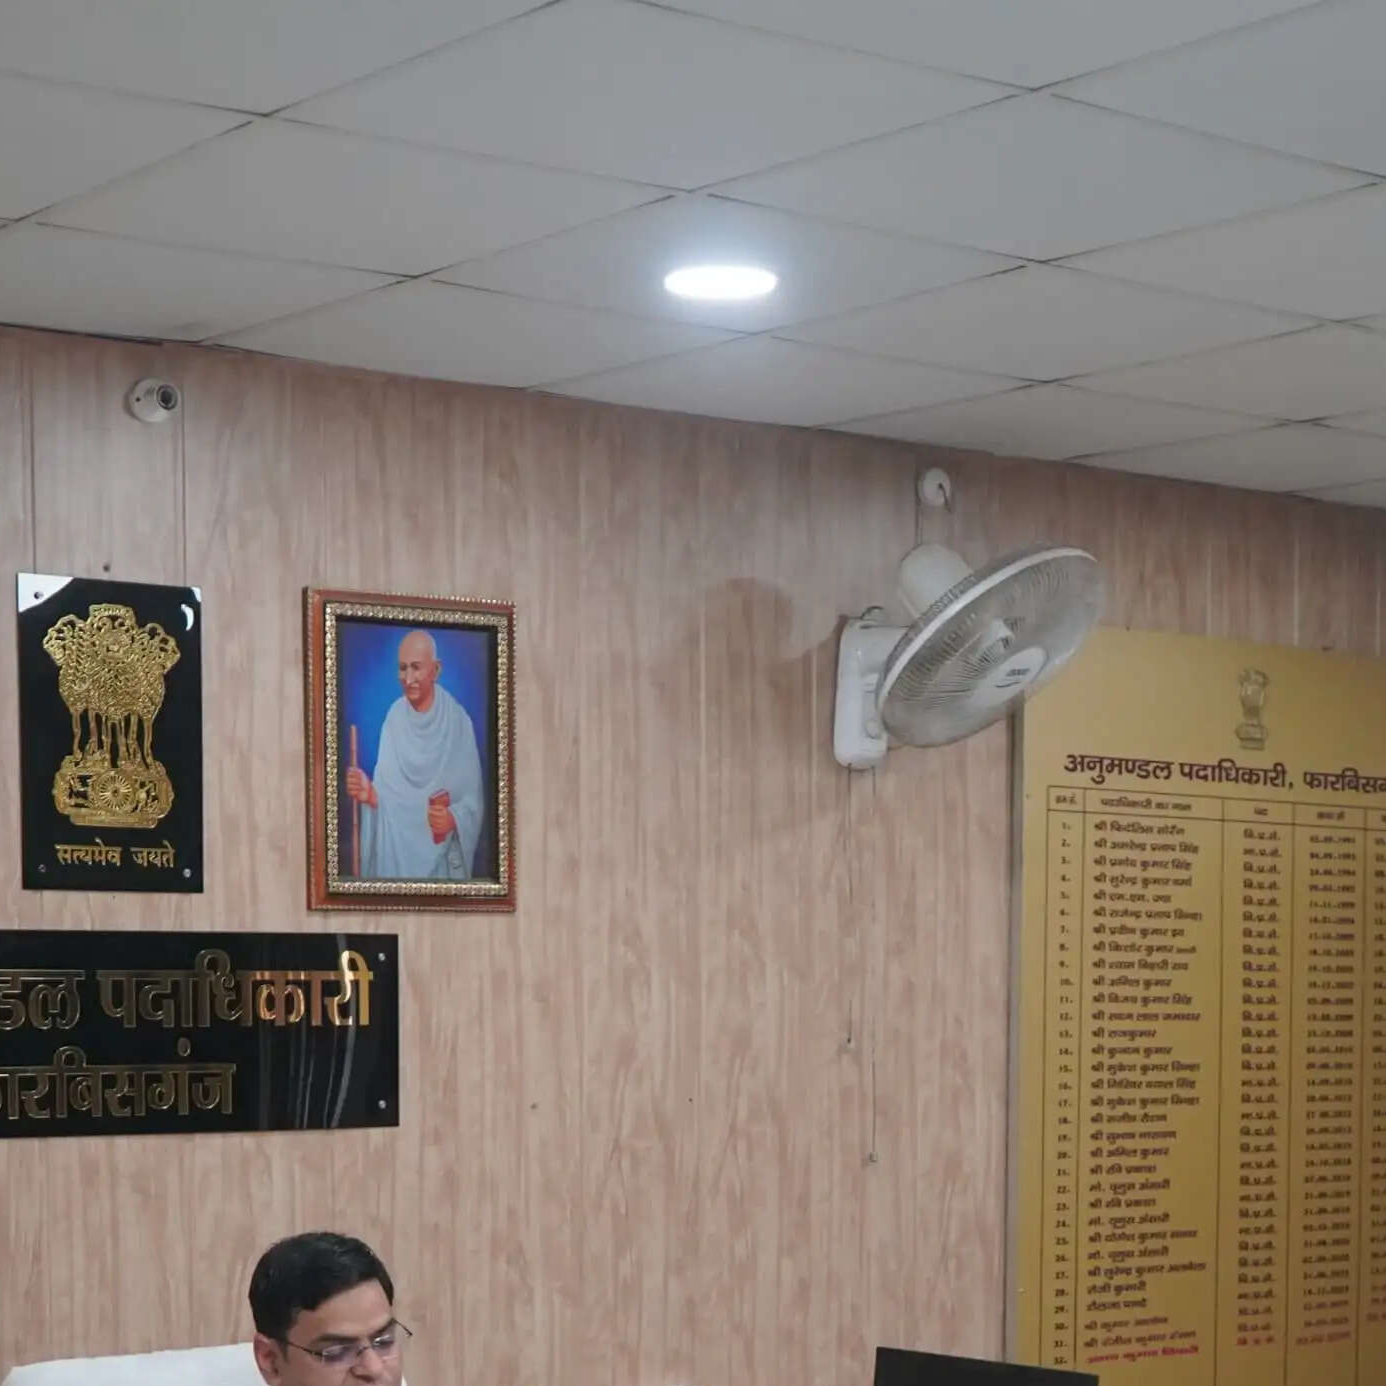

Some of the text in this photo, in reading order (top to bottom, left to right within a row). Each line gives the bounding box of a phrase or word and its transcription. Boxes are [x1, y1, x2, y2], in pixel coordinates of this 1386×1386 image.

[1064, 754, 1174, 785] अनुमण्डल
[1179, 758, 1294, 790] पदाधिकारी,
[55, 837, 175, 868] सत्यमेव जयते
[96, 949, 373, 1030] पदाधिकारी
